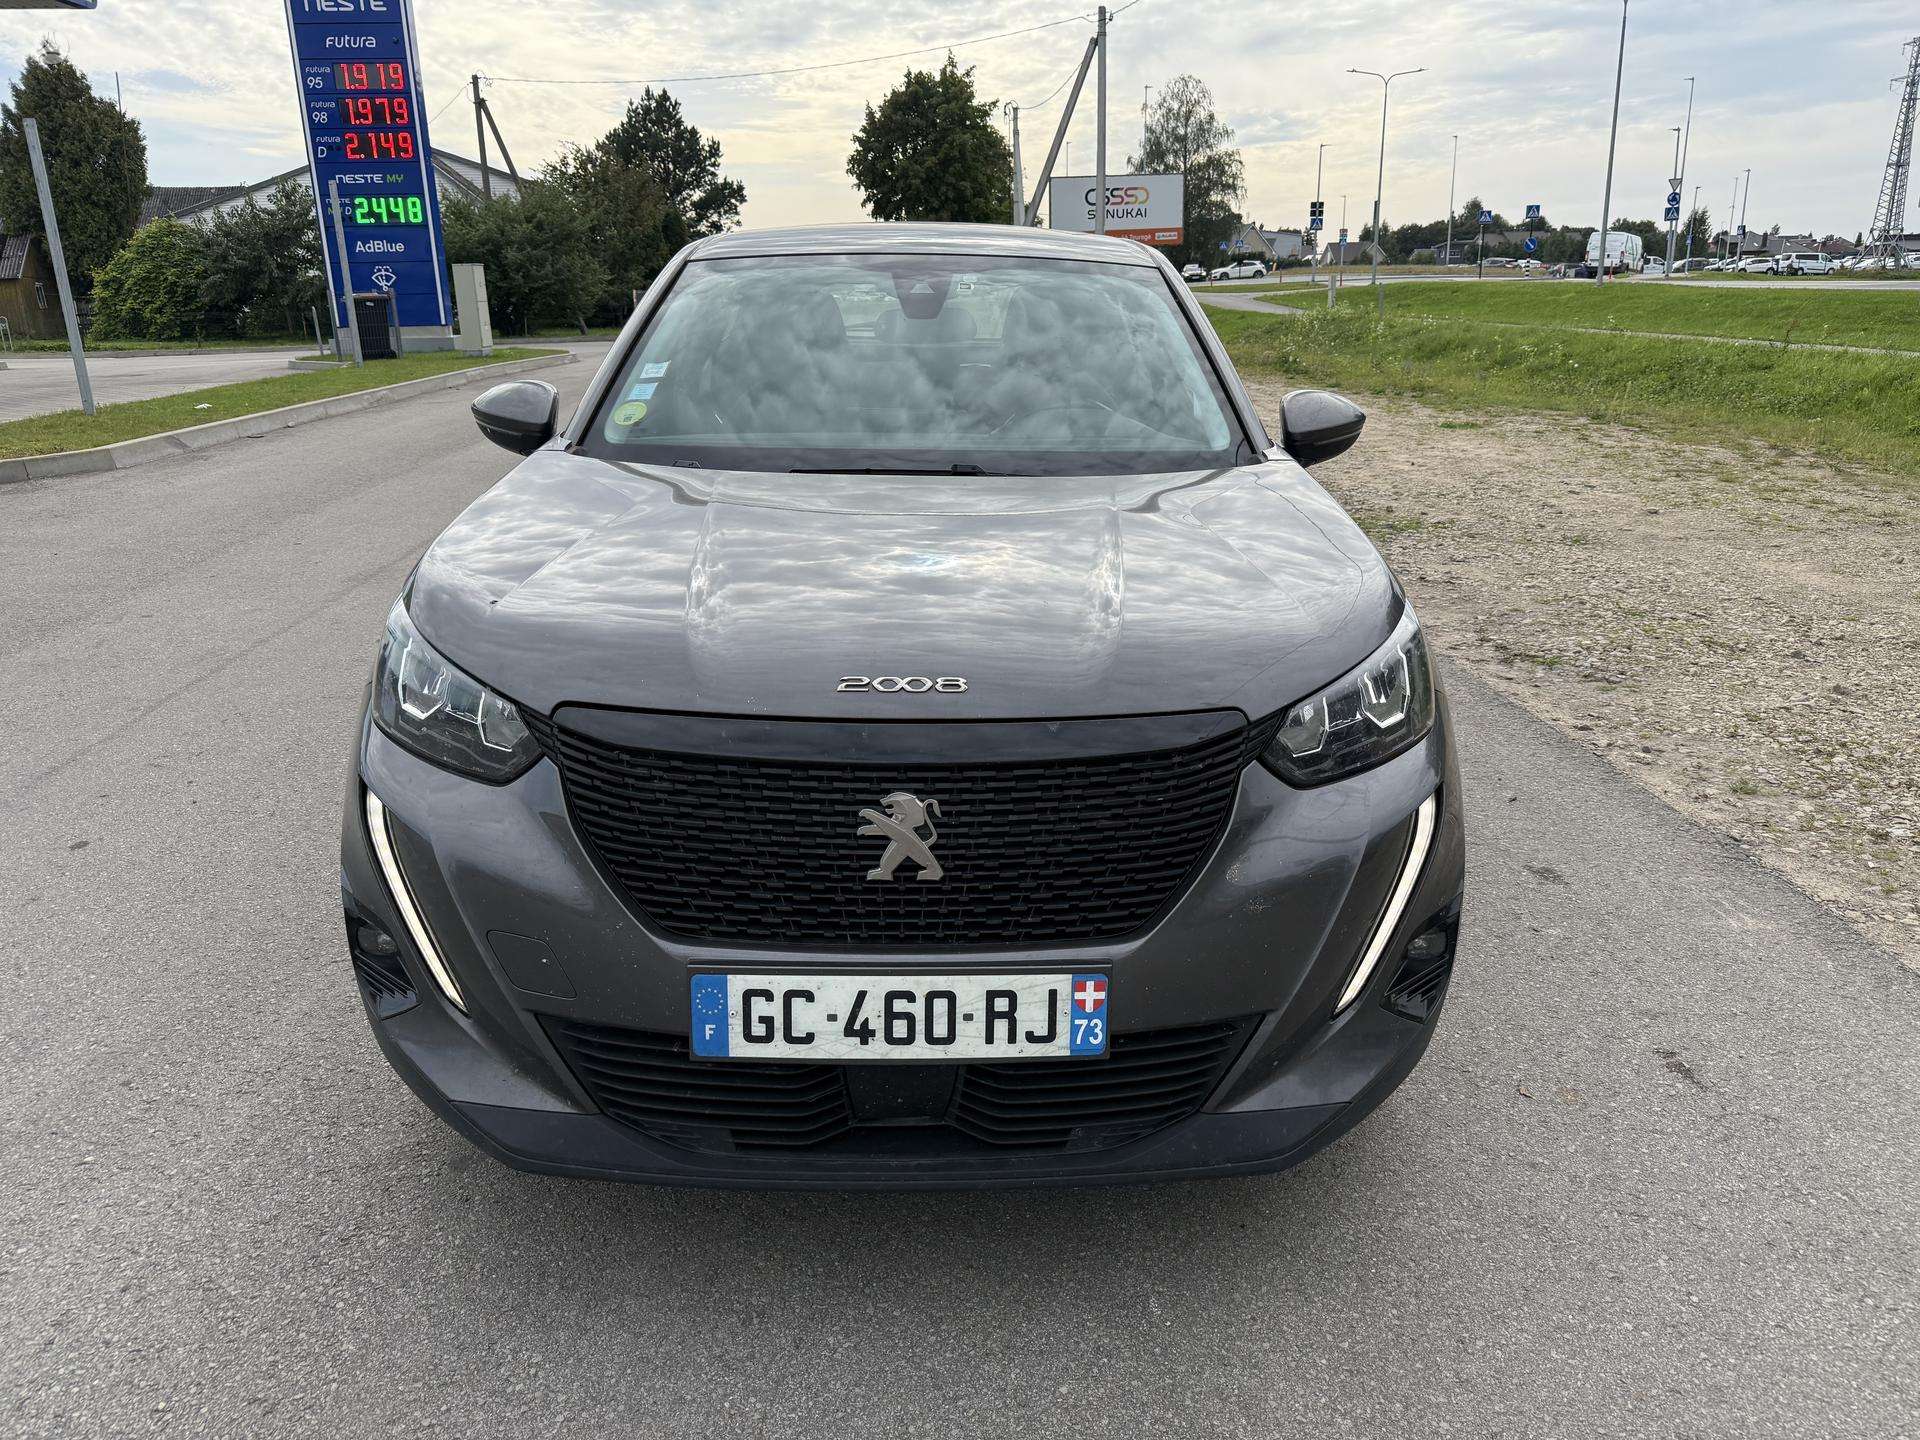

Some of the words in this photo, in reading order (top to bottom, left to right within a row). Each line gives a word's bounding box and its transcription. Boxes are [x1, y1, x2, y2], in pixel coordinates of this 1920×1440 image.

[325, 34, 376, 48] Futura
[307, 77, 322, 88] 95
[340, 63, 404, 90] 1.919
[312, 111, 328, 124] 98
[345, 97, 409, 125] 1.979
[318, 147, 327, 158] D
[344, 132, 414, 159] 2.149
[336, 174, 384, 183] NESTE
[387, 175, 403, 183] MY
[346, 207, 352, 215] D
[353, 196, 423, 224] 2.448
[1087, 207, 1147, 220] SNUKAI
[355, 239, 405, 253] AdBlue
[836, 676, 968, 693] 2008
[741, 988, 1058, 1046] GC-460-RJ
[704, 1024, 716, 1040] F
[1074, 1018, 1103, 1045] 73
